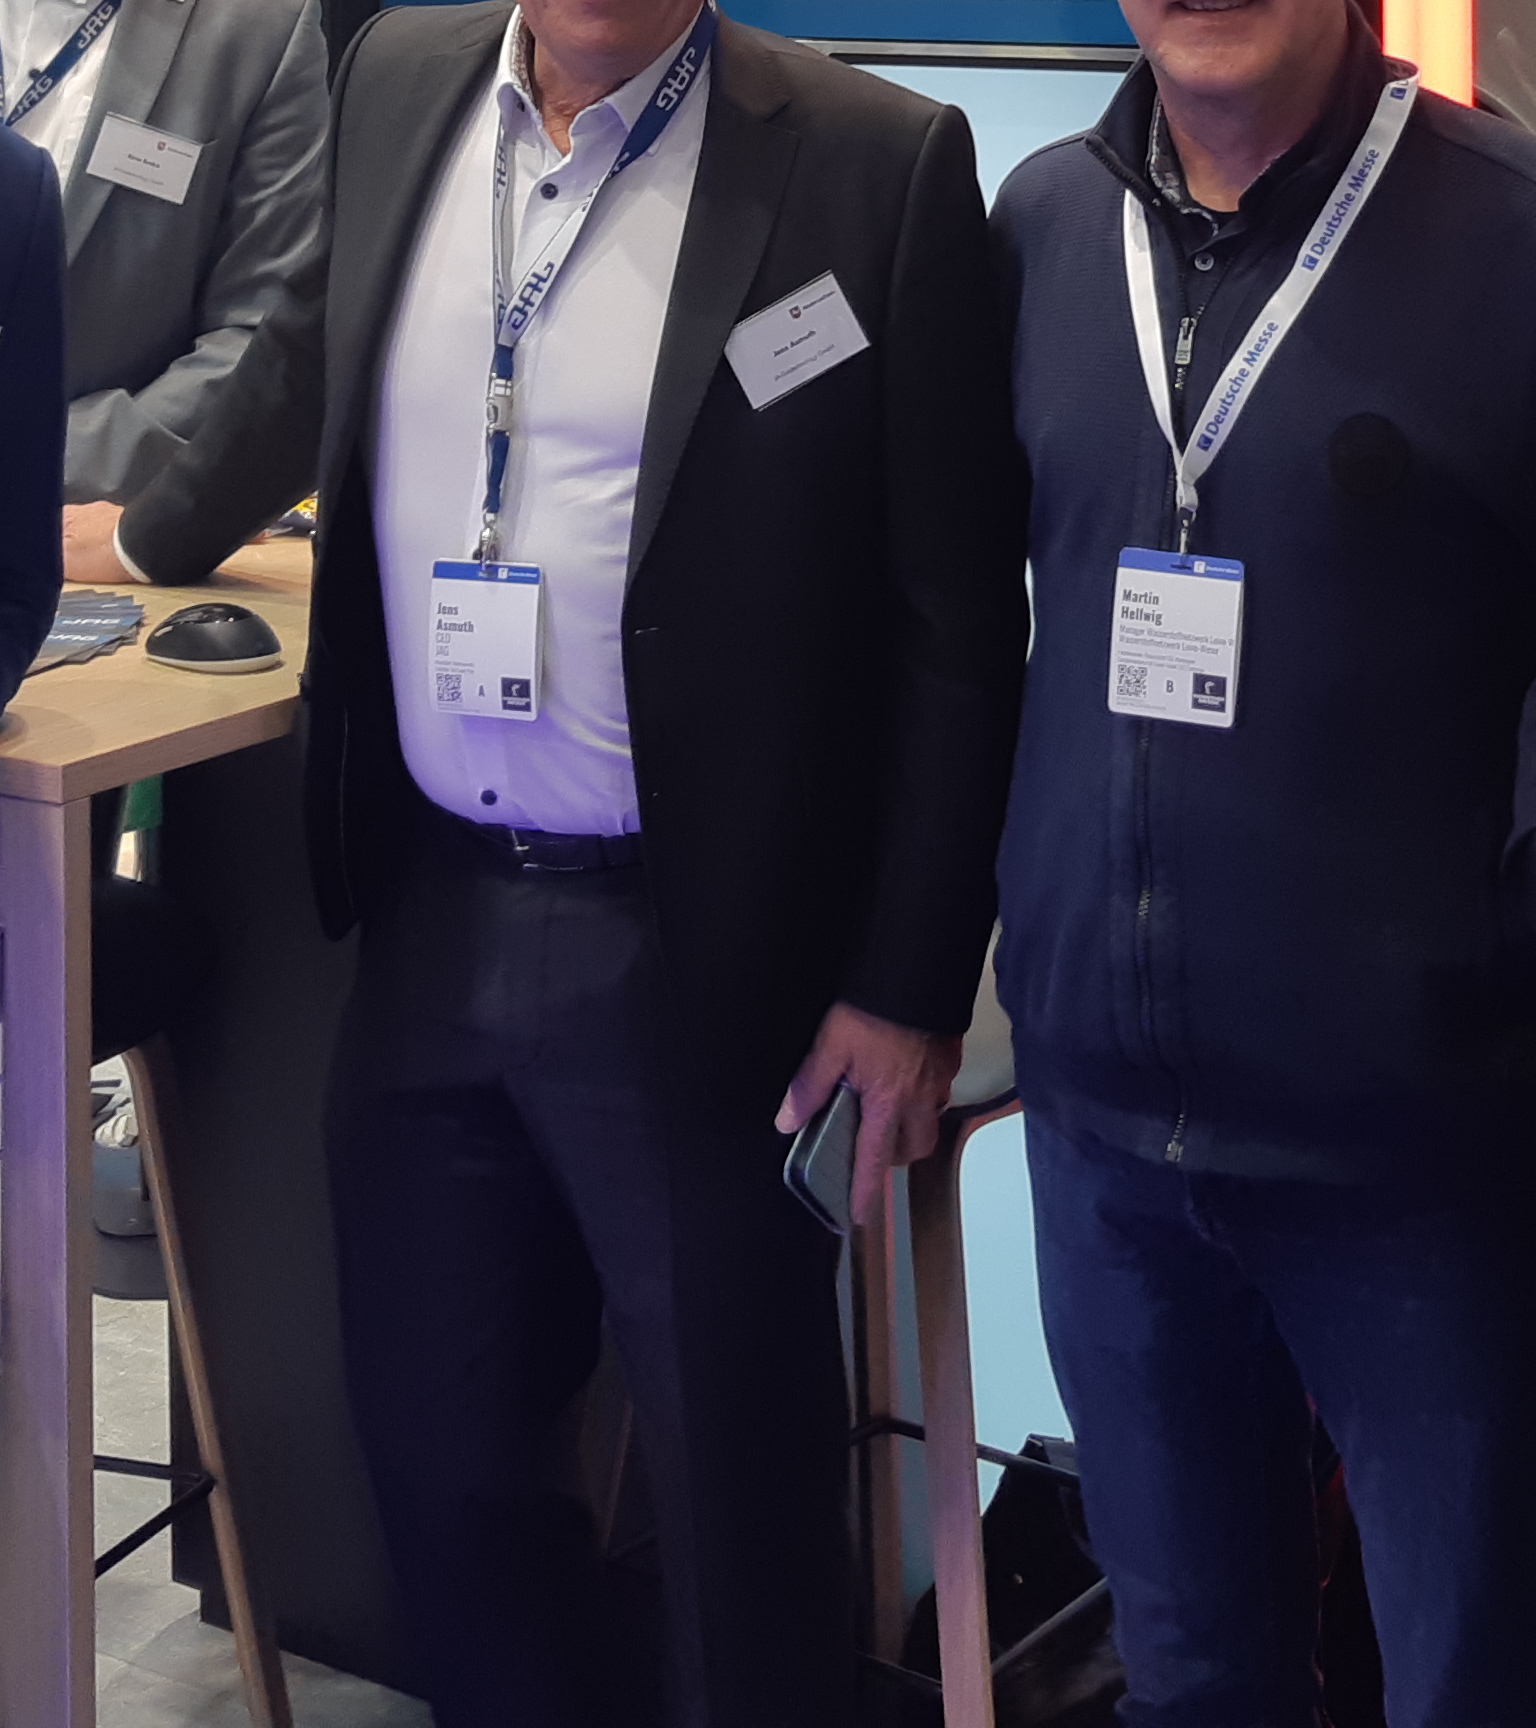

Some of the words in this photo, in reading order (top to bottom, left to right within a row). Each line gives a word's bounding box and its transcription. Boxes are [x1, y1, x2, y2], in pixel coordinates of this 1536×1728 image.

[656, 46, 696, 112] JAG
[1310, 189, 1357, 258] Deutsche
[1349, 147, 1381, 191] Messe
[1205, 364, 1251, 437] Deutsche
[1243, 319, 1281, 369] Messe
[1120, 605, 1163, 626] Hellwig
[1122, 588, 1160, 606] Martin
